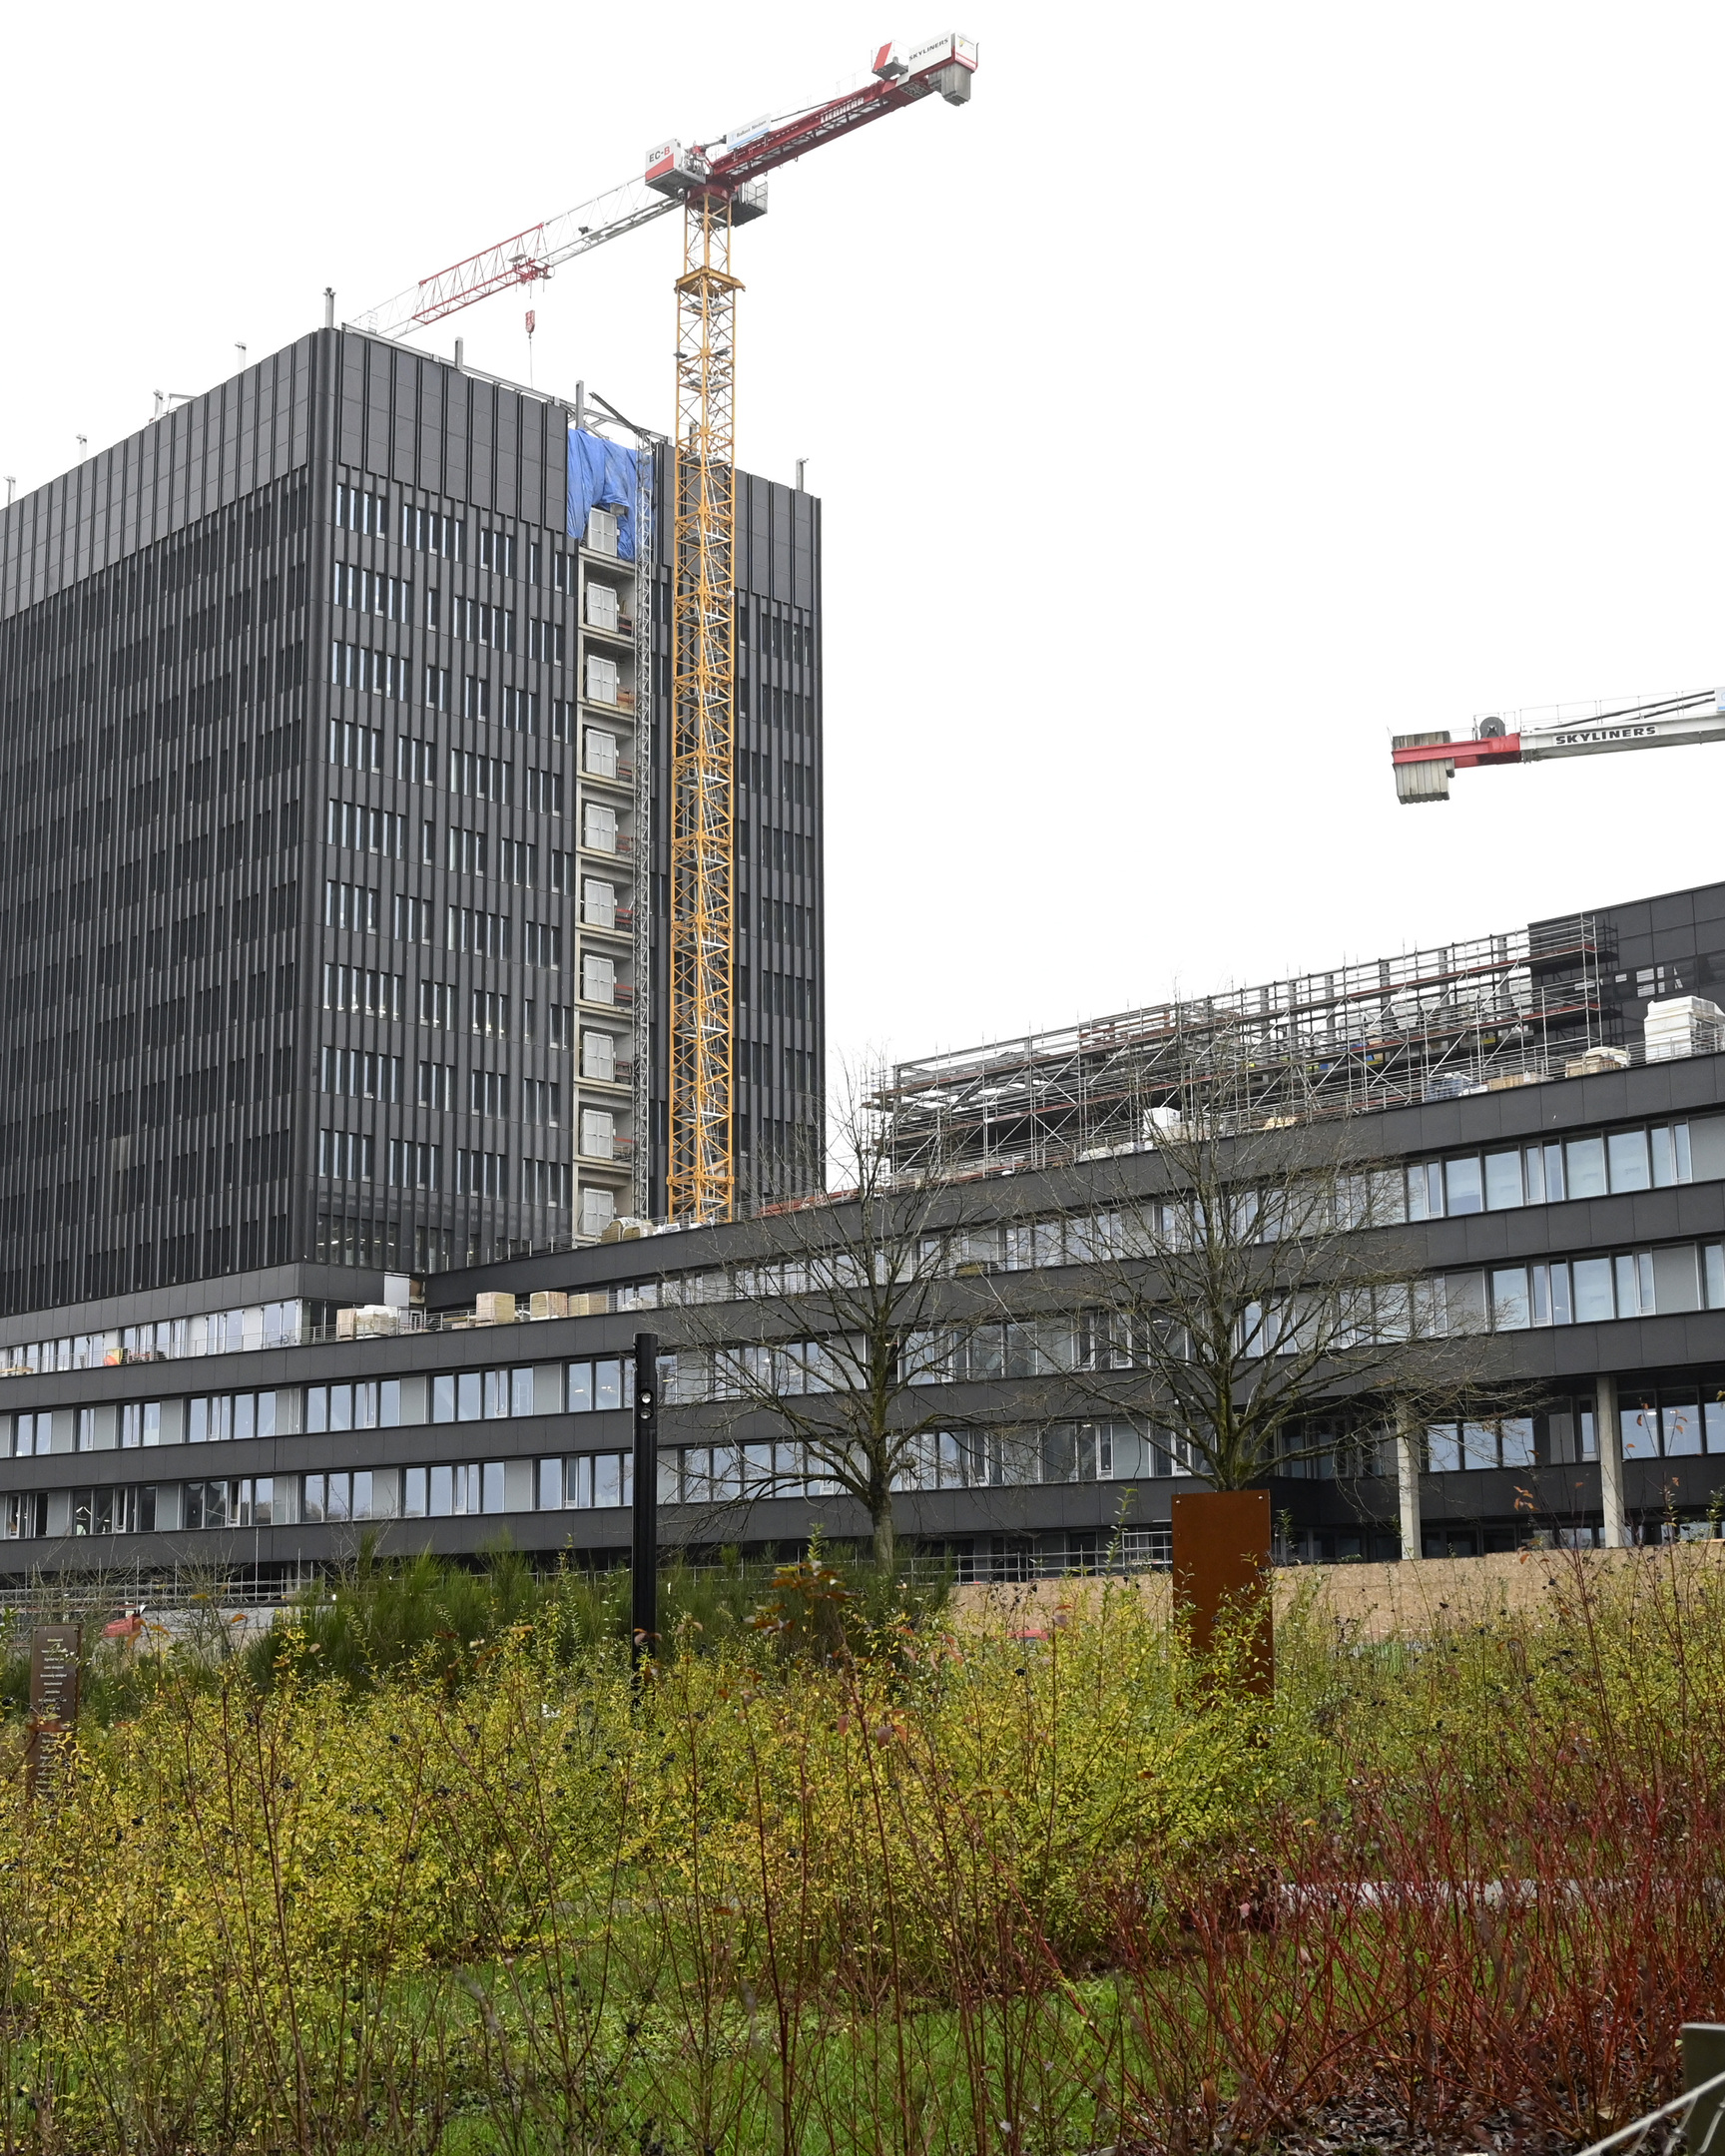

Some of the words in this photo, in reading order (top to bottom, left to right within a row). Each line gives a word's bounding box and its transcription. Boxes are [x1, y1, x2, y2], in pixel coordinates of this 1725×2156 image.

[908, 37, 948, 61] SKYLINERS
[820, 97, 864, 124] LIEBHERR
[649, 146, 671, 163] EC-B
[1555, 726, 1656, 745] SKYLINERS
